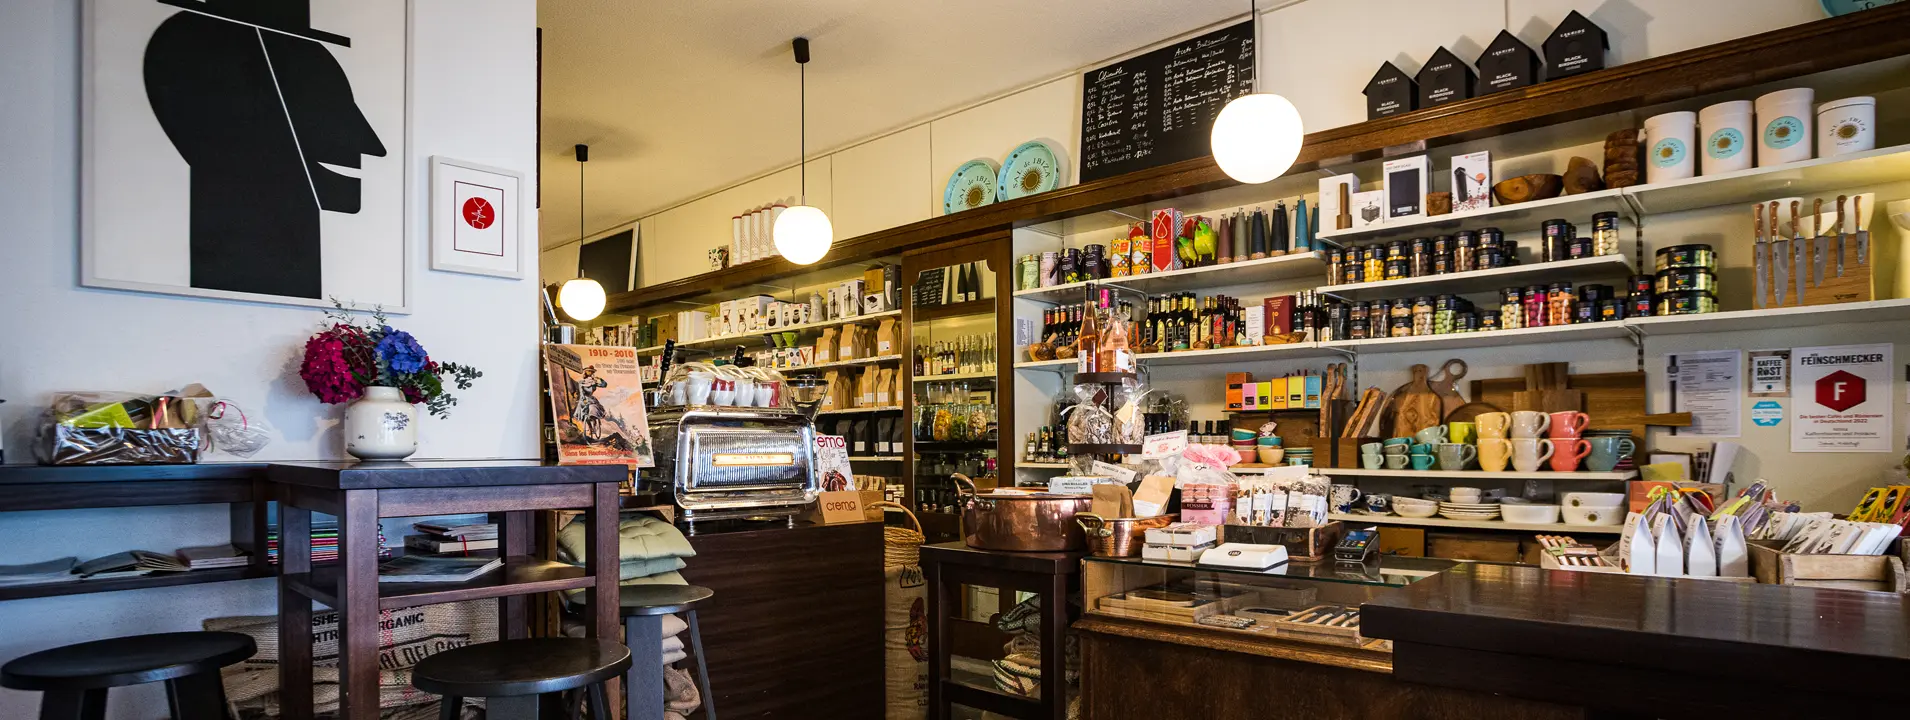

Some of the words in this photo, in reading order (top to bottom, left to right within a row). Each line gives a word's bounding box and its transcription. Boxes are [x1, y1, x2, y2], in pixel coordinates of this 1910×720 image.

[1558, 58, 1588, 68] BIRDHOUSE
[1490, 76, 1518, 84] BIRDHOUSE
[1429, 90, 1454, 99] BIRDHOUSE
[1013, 170, 1021, 188] SAL
[1032, 158, 1050, 178] IBIZA
[958, 188, 966, 205] SAL
[976, 175, 992, 194] IBIZA
[1801, 354, 1883, 365] FEINSCHMECKER
[1834, 382, 1847, 401] F
[826, 501, 856, 511] crema
